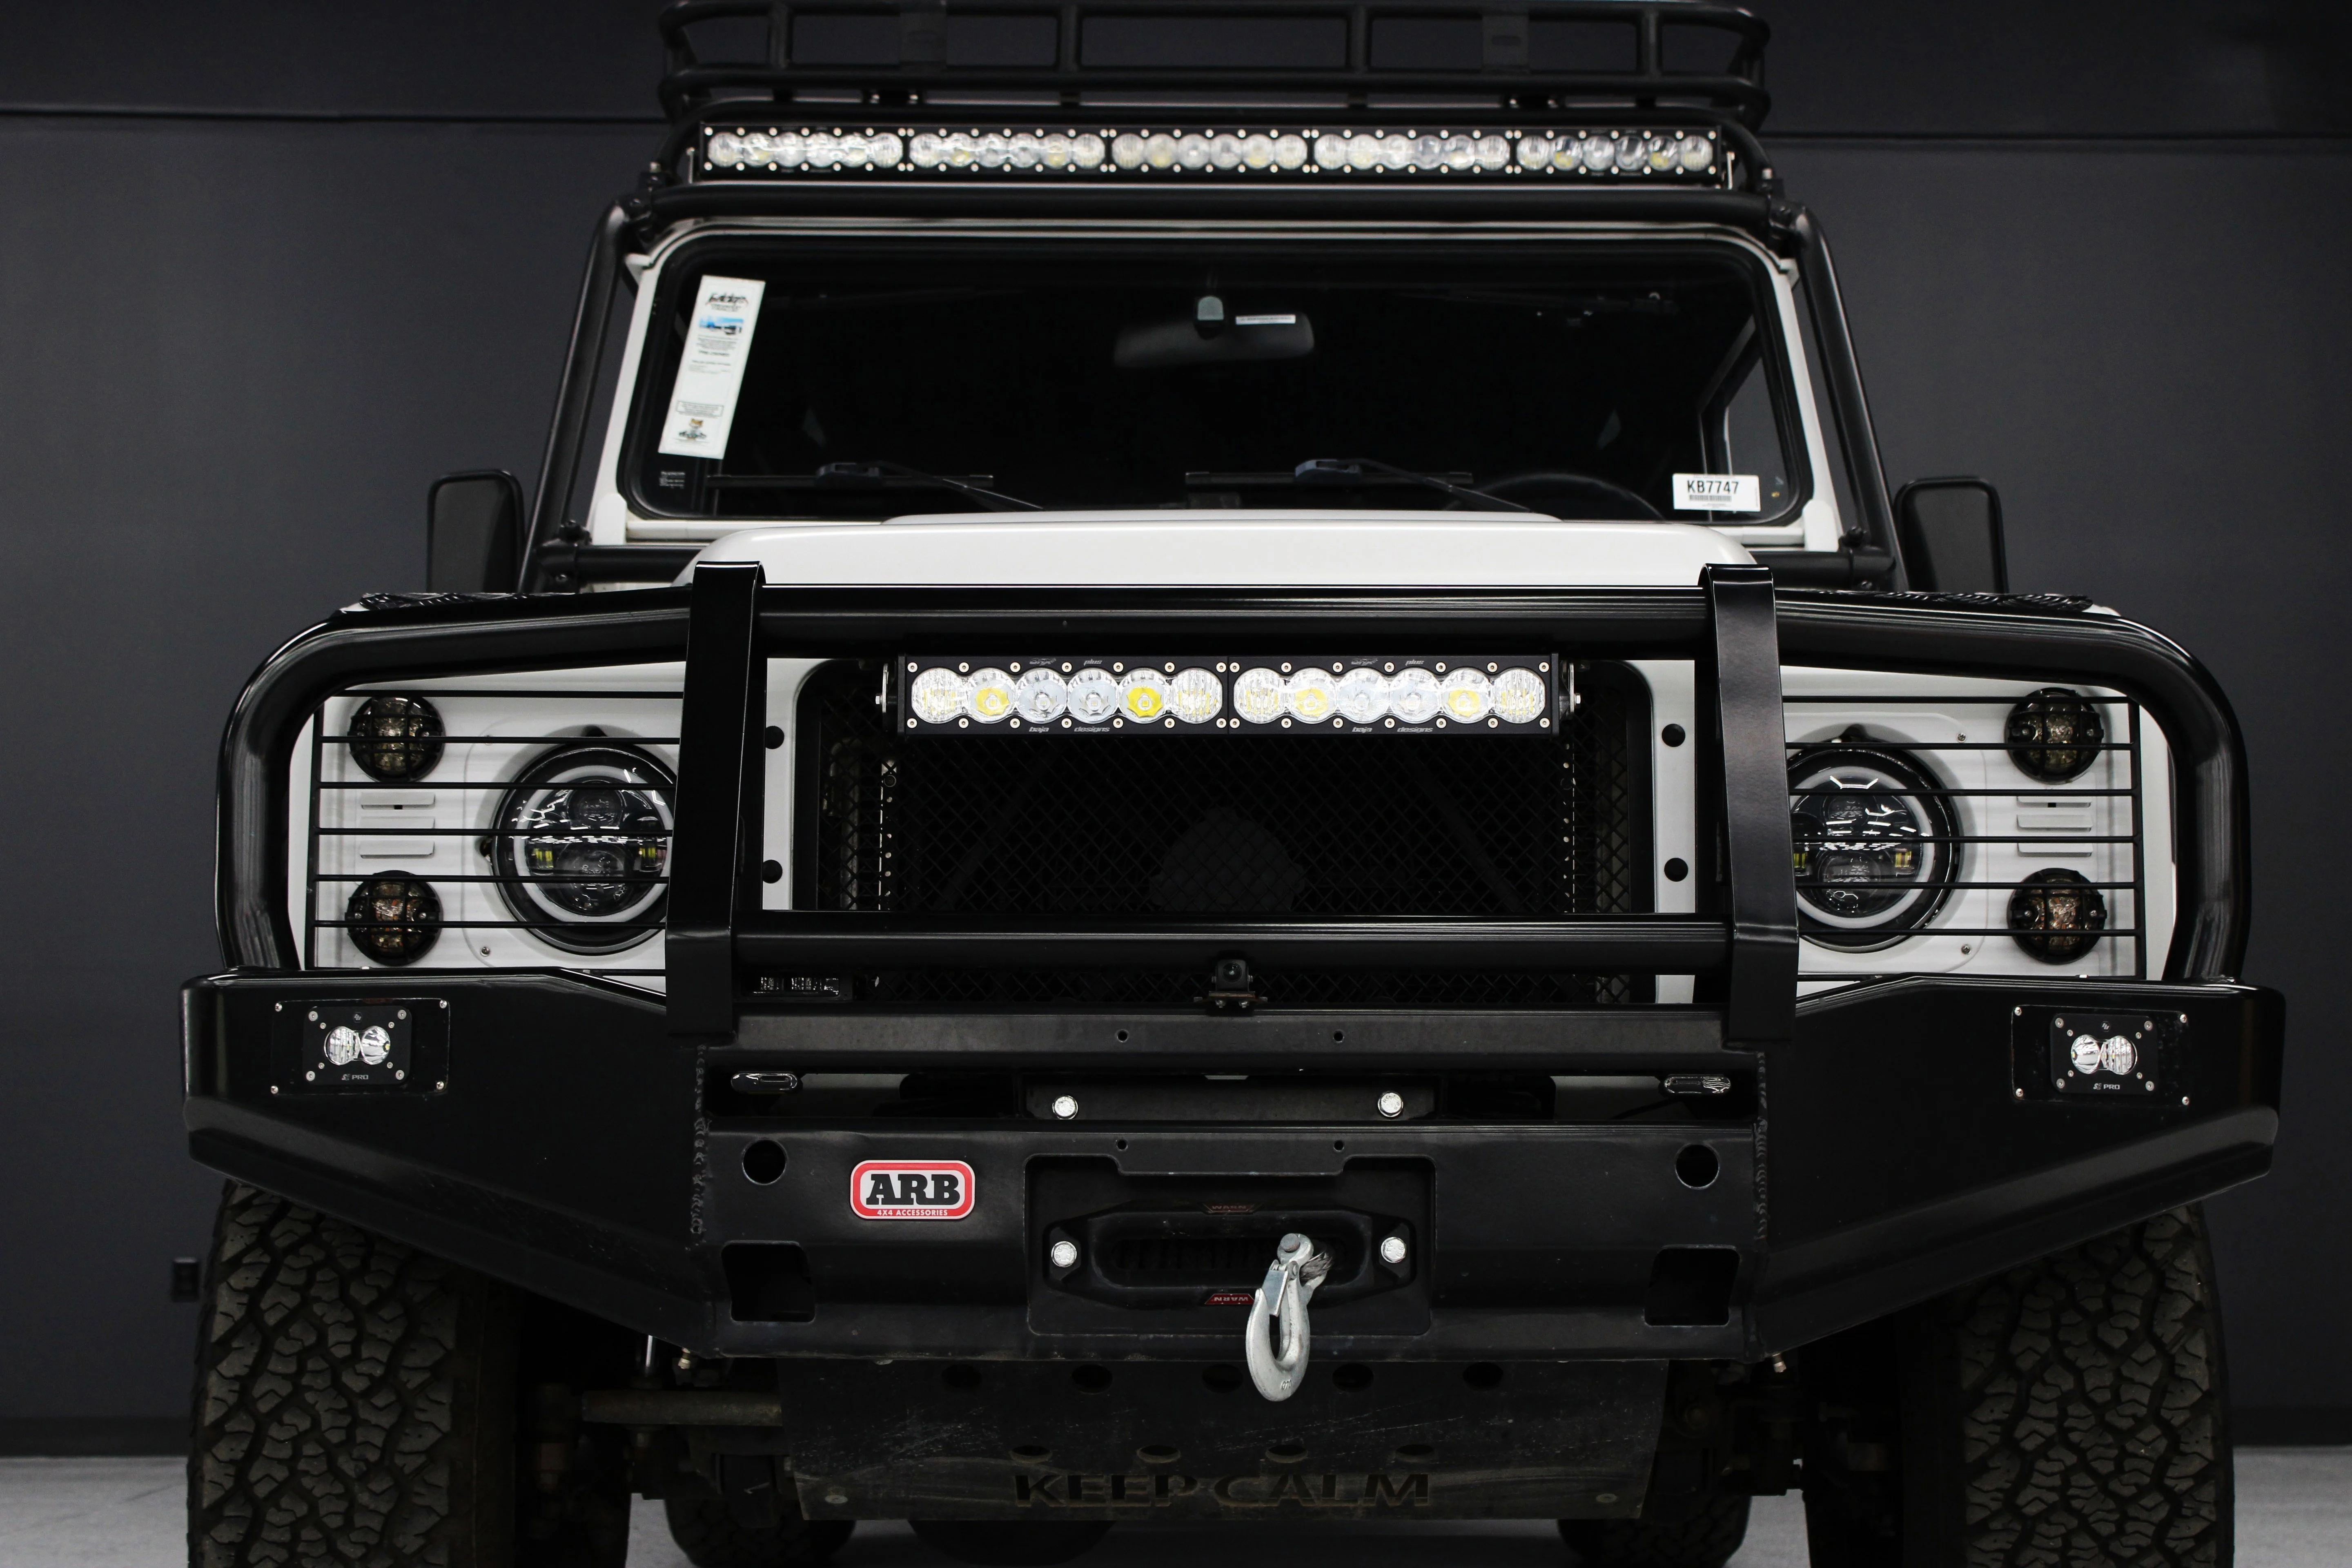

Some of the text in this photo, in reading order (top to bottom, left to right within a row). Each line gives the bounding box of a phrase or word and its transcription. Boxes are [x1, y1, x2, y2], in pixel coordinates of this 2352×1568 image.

[1687, 480, 1739, 494] KB7747
[866, 1174, 960, 1205] ARB
[1015, 1474, 1430, 1507] KEEP CALM
